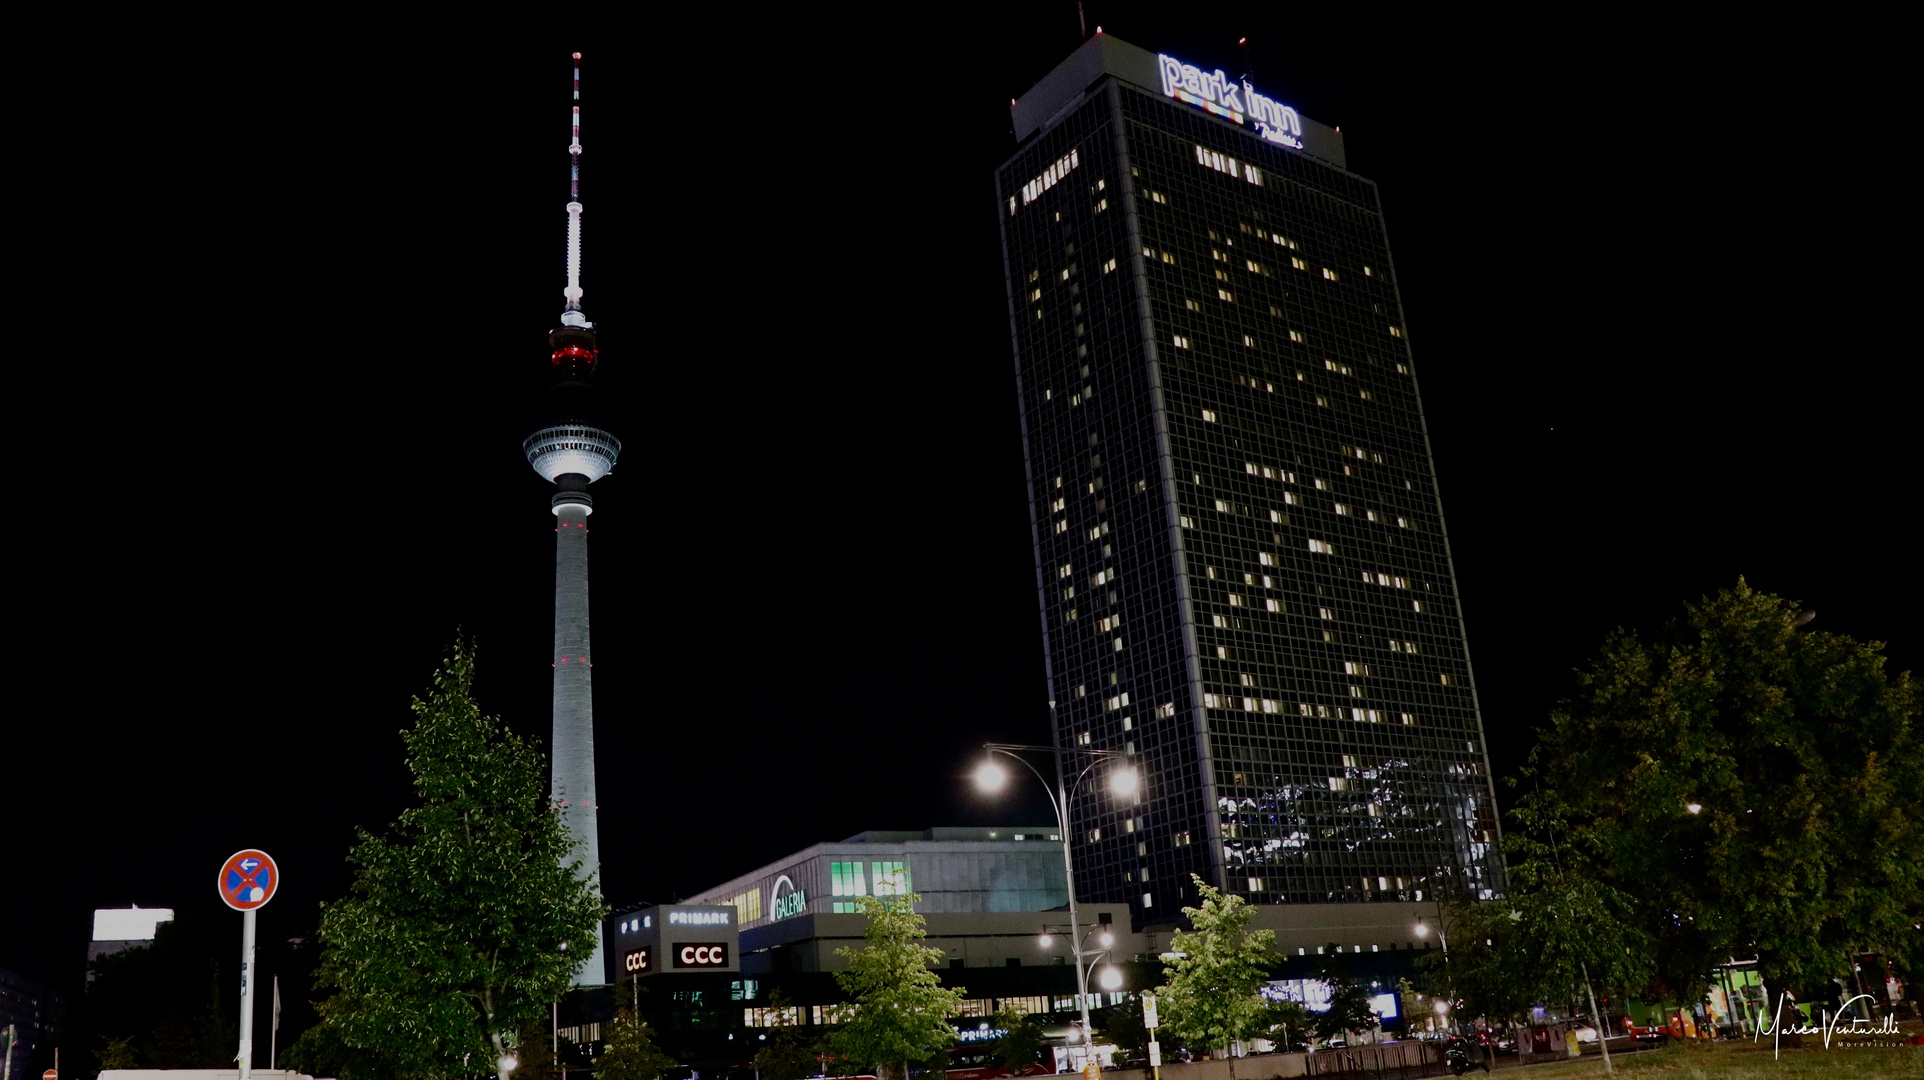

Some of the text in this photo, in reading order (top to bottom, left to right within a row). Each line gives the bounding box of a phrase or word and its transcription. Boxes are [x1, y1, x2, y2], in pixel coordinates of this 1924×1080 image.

[1158, 53, 1244, 113] park
[1243, 79, 1302, 136] inn
[776, 889, 807, 920] GALERIA
[670, 912, 729, 925] PRIMARK
[626, 951, 647, 972] CCC
[681, 947, 723, 964] CCC
